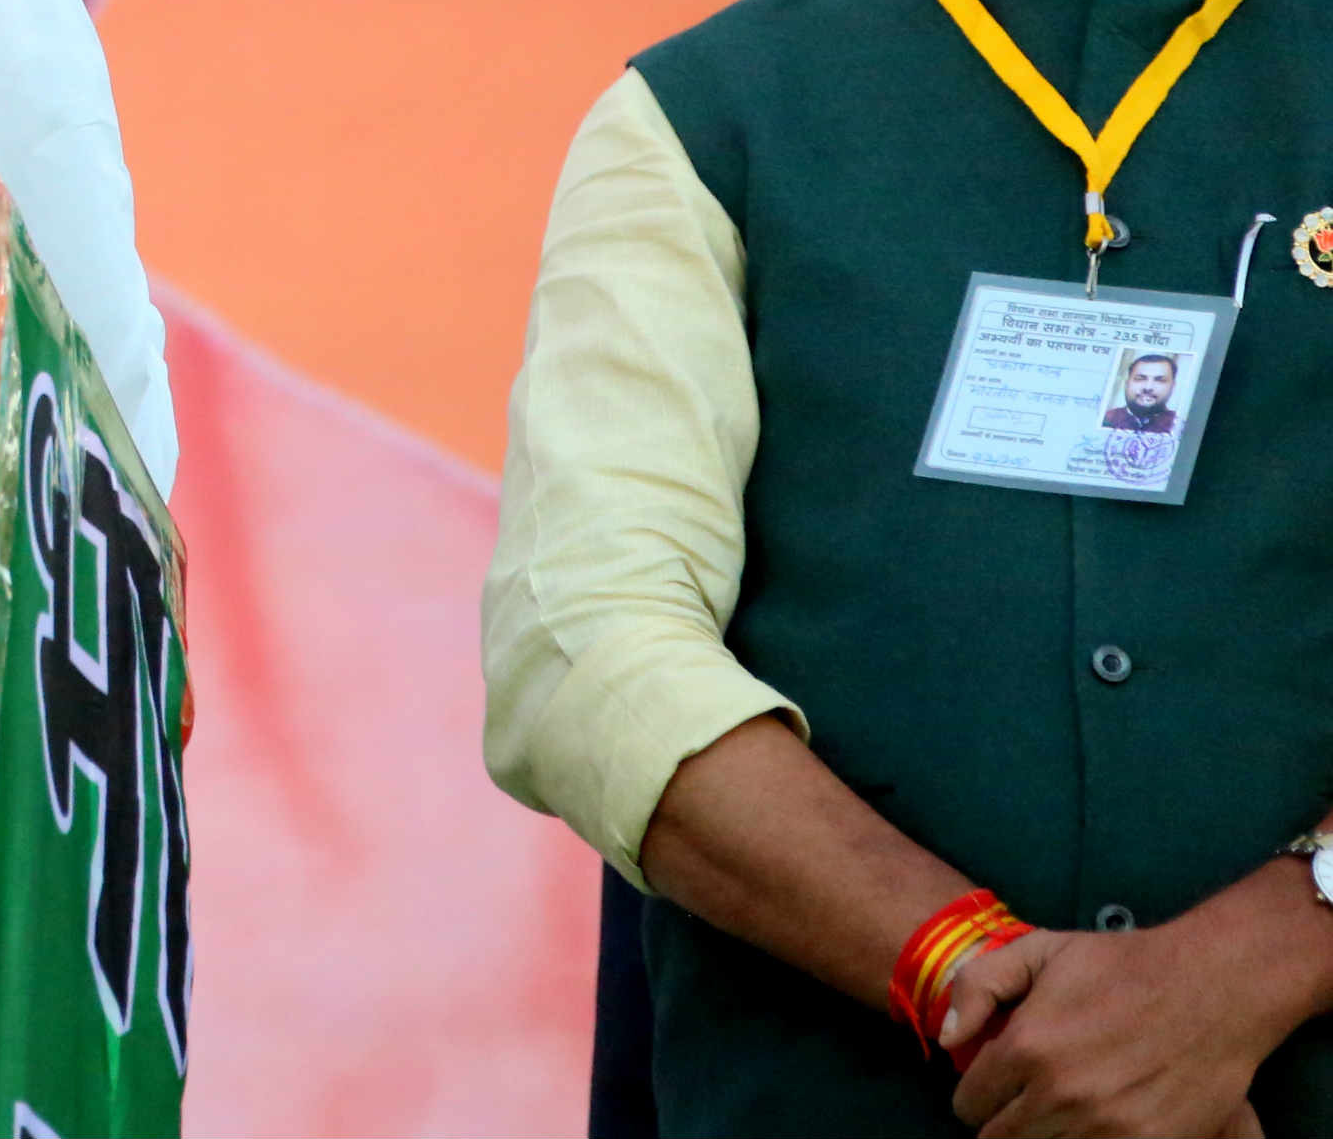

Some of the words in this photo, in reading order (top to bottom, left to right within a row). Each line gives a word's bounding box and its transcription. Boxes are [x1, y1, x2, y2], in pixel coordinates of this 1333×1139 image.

[1002, 315, 1039, 331] विधान
[1044, 323, 1070, 335] सभा
[1113, 331, 1139, 342] 235
[1026, 338, 1043, 349] का
